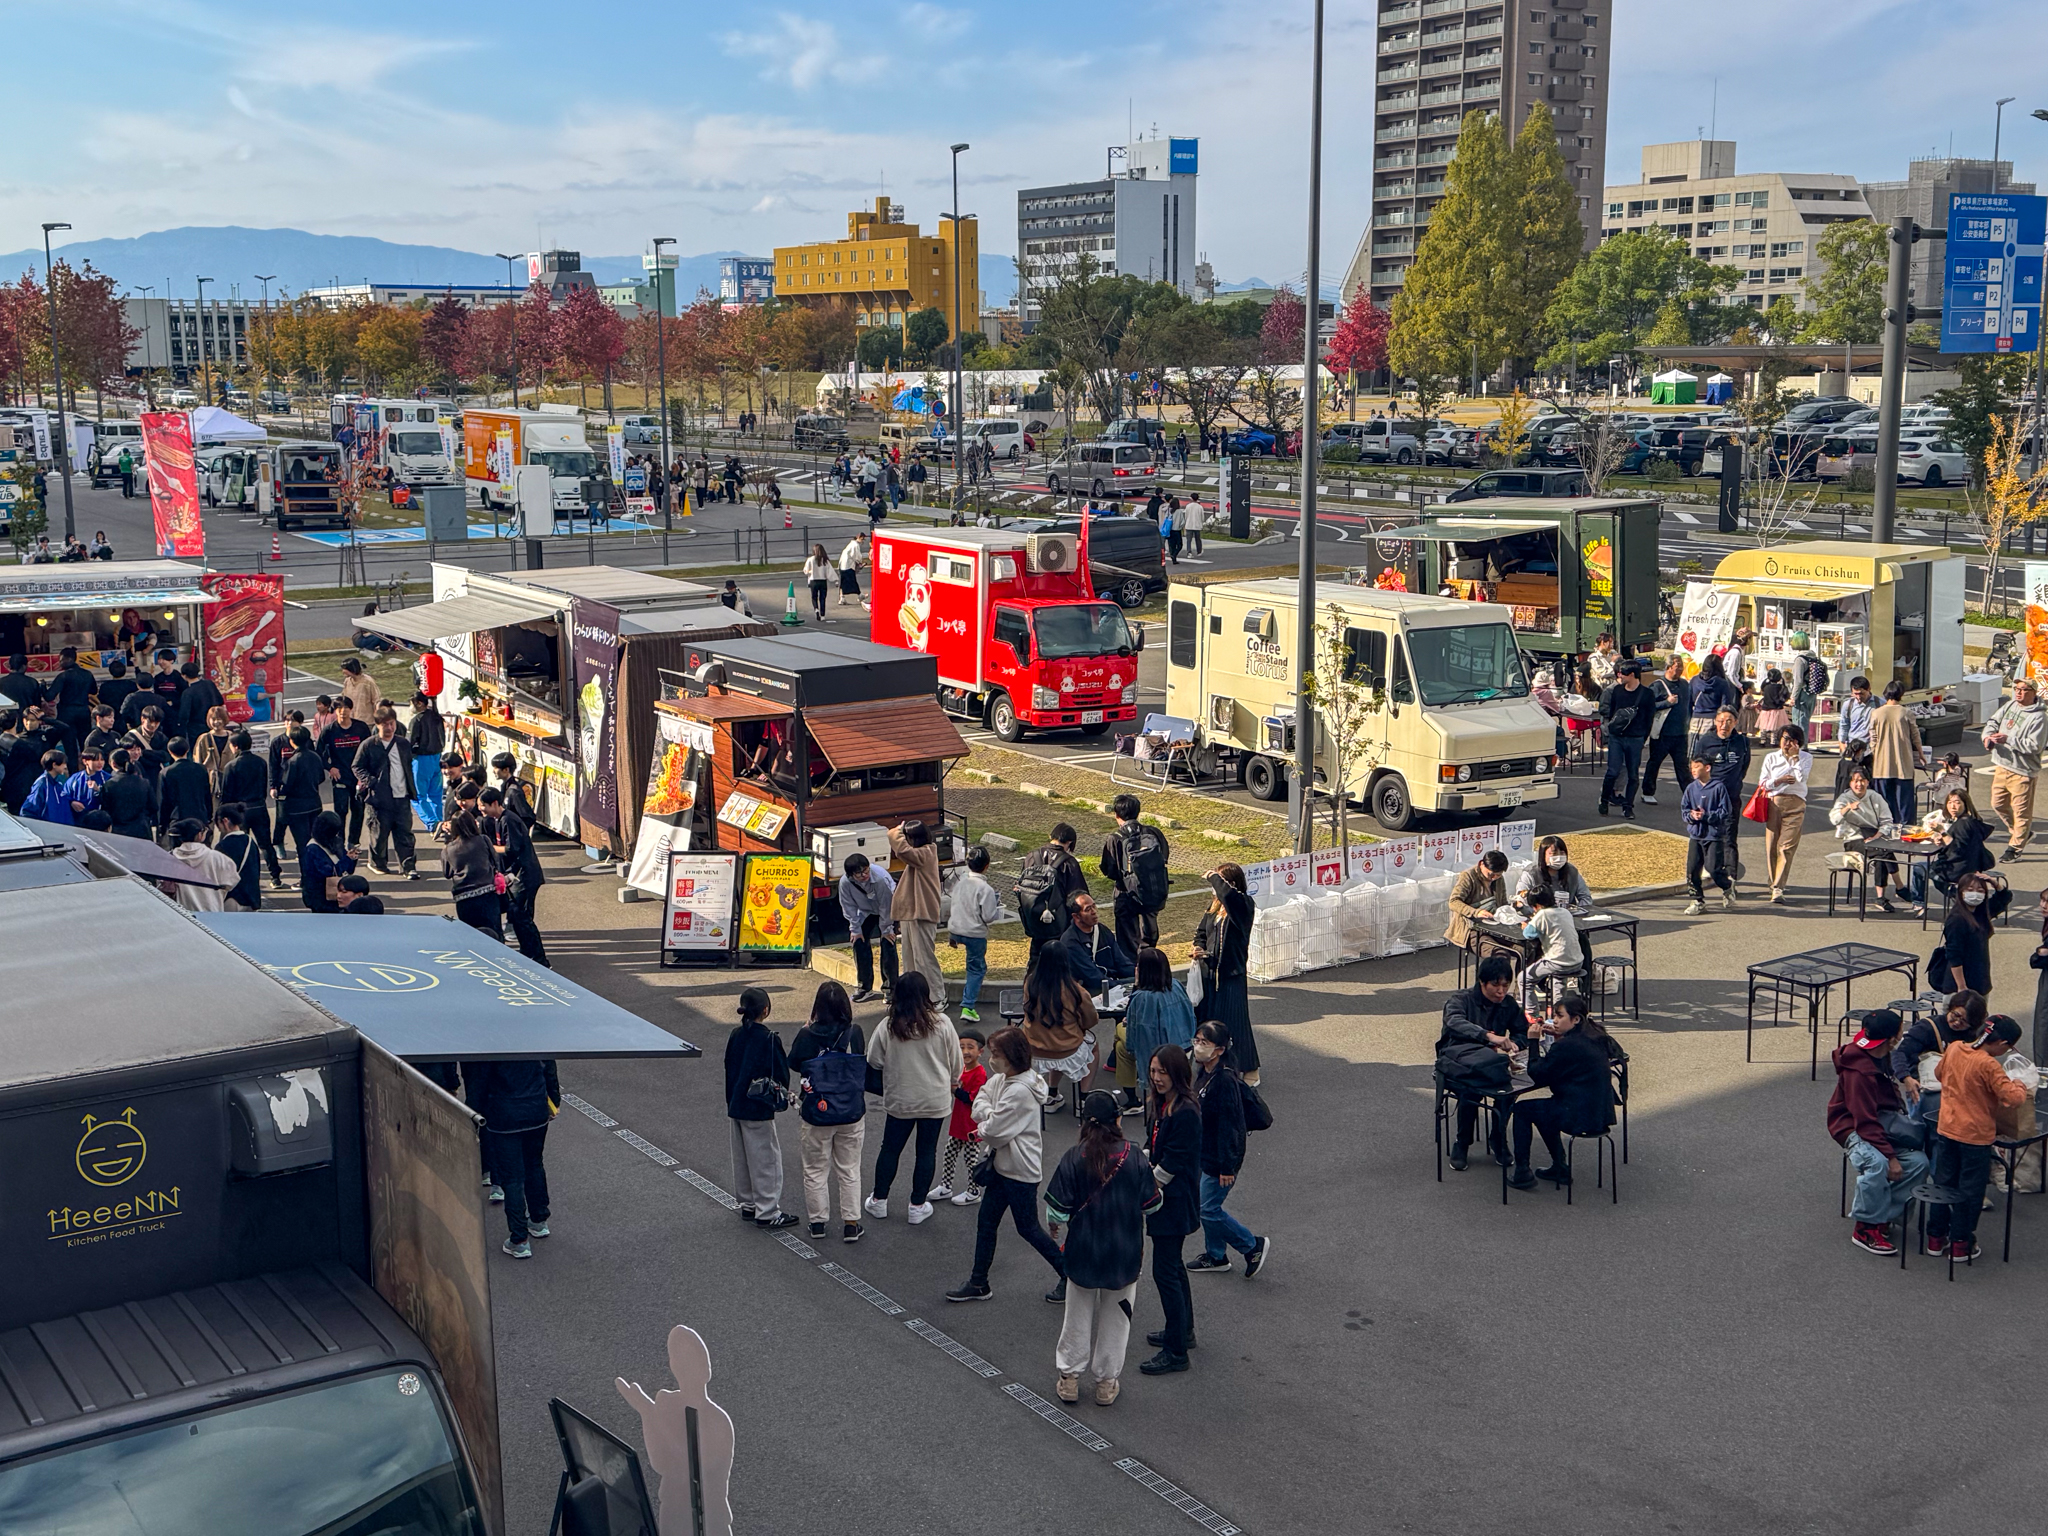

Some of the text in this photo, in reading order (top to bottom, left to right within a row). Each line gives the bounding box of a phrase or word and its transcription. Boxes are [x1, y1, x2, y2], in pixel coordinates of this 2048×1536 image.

[1953, 196, 1961, 210] P
[1993, 225, 2002, 235] P5
[1991, 265, 1999, 275] P1
[1989, 291, 1998, 301] P2
[1960, 318, 1983, 327] アリーナ
[1987, 317, 1996, 327] P3
[2015, 317, 2024, 326] P4
[1238, 459, 1250, 470] P3
[1583, 535, 1609, 556] Life is
[1783, 565, 1860, 579] Fruits Chishun
[1591, 579, 1613, 591] BEEF
[1687, 612, 1708, 624] Fresh
[936, 616, 967, 636] コッペ亭
[574, 621, 617, 648] わらび餅ドリンク
[1247, 637, 1281, 655] Coffee
[1265, 654, 1288, 667] Stand
[1078, 681, 1103, 689] ISUZU
[1501, 823, 1534, 832] ペットボトル
[1462, 830, 1495, 841] もえるゴミ
[1424, 836, 1456, 848] もえるゴミ
[1314, 850, 1341, 861] もえるゴミ
[1350, 847, 1385, 860] もえるゴミ
[1272, 859, 1308, 873] もえるゴミ
[755, 868, 800, 877] CHURROS
[674, 916, 690, 925] 炒飯
[418, 950, 554, 1006] HeeeNN
[47, 1186, 181, 1233] HeeeNN
[67, 1221, 166, 1248] Kitchen Food Truck
